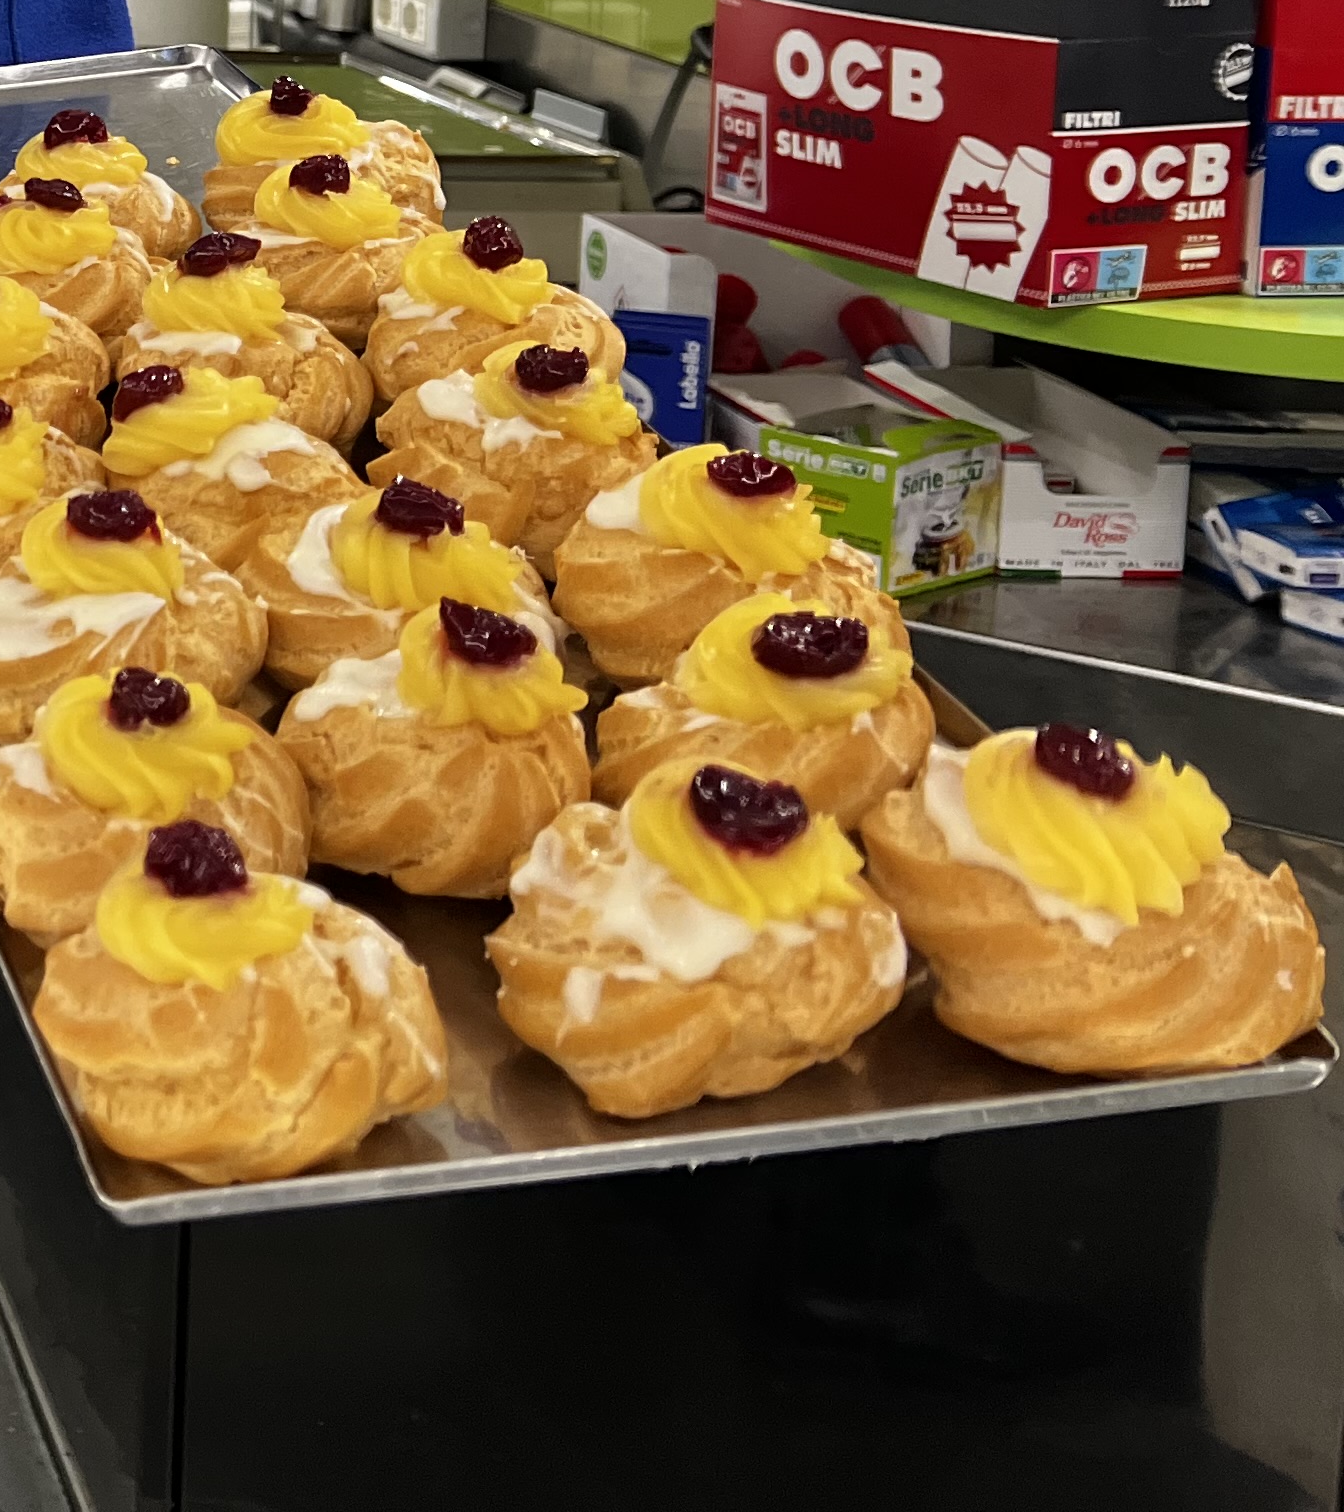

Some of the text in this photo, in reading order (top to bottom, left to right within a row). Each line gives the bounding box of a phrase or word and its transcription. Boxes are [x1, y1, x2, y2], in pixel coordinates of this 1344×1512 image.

[775, 29, 944, 122] OCB
[1063, 111, 1120, 130] FILTRI
[775, 129, 842, 170] SLIM
[1088, 142, 1231, 204] OCB
[1173, 198, 1227, 222] SLIM
[676, 340, 701, 410] Labello
[767, 438, 825, 471] Serie
[901, 469, 943, 498] Serie
[1053, 511, 1108, 530] David
